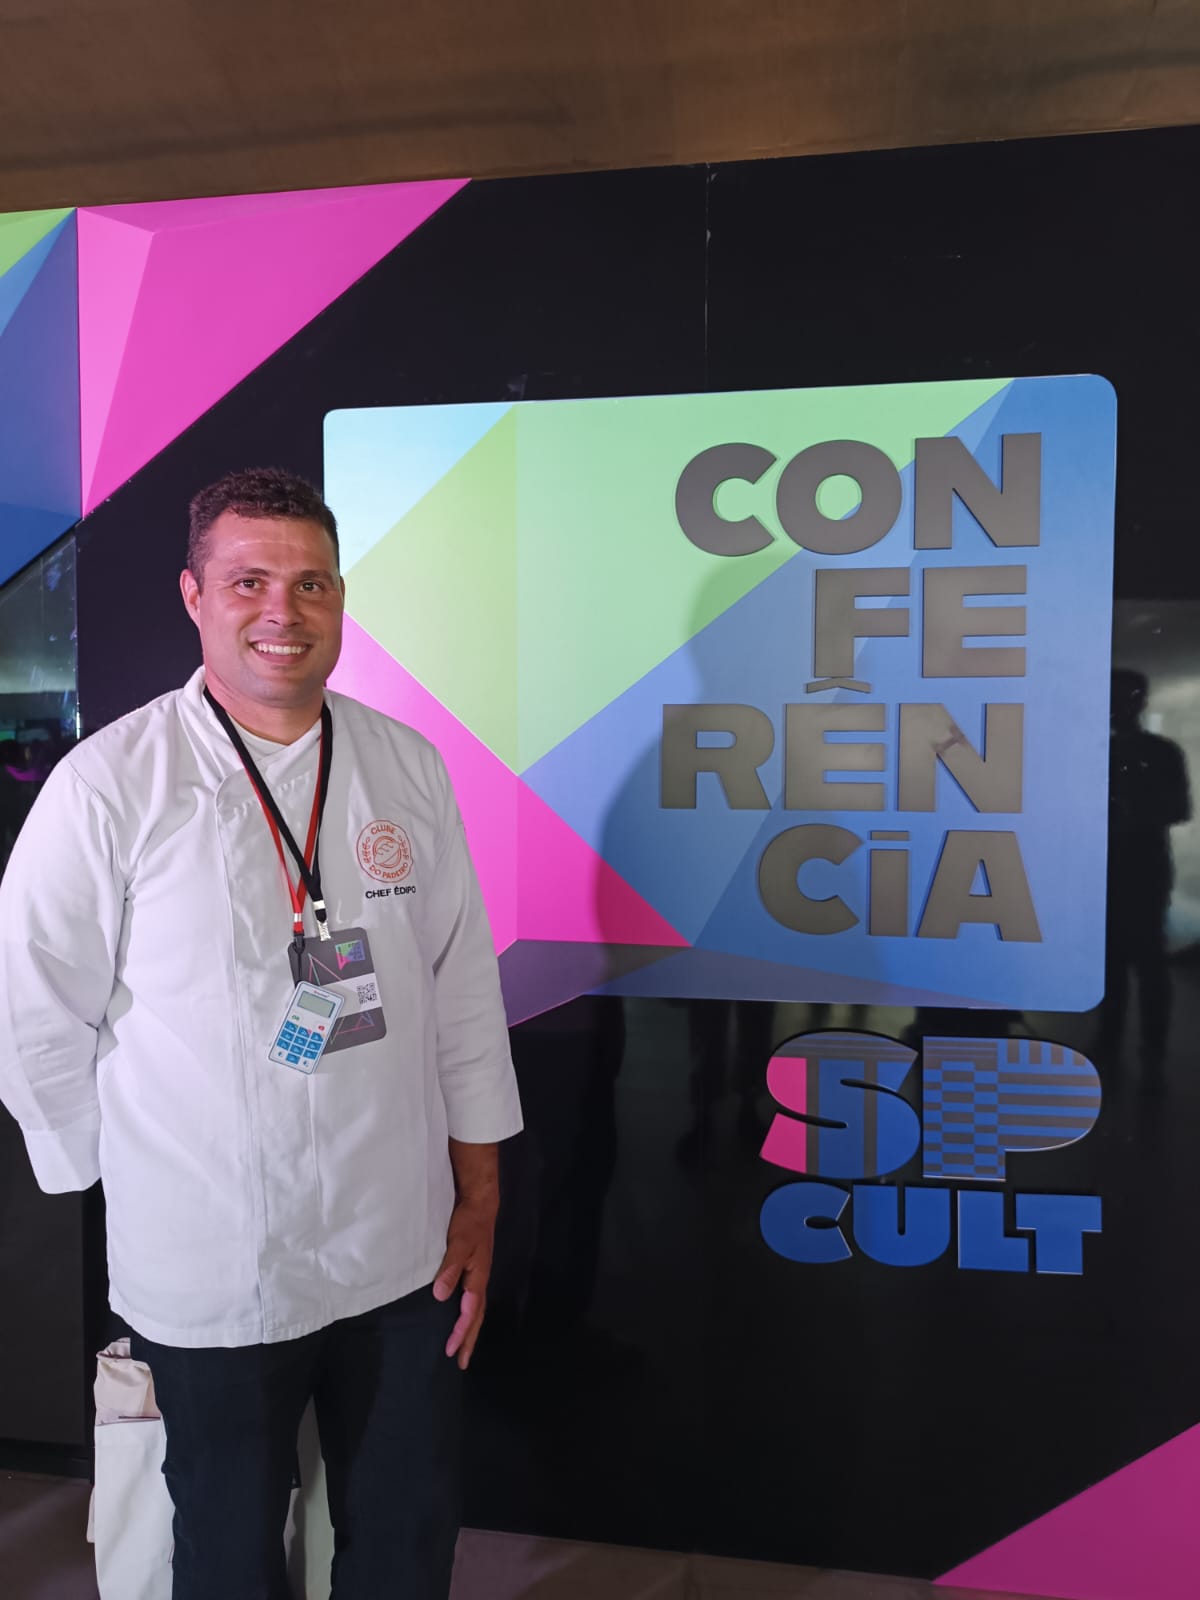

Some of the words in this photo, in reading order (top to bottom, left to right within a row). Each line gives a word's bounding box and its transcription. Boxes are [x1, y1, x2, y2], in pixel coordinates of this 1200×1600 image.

[675, 432, 1041, 556] CON
[814, 565, 1027, 678] FE
[661, 677, 1024, 813] RÊN
[365, 888, 391, 898] CHEF
[370, 866, 381, 875] DO
[759, 1031, 1102, 1182] SP
[760, 1182, 1102, 1275] CULT
